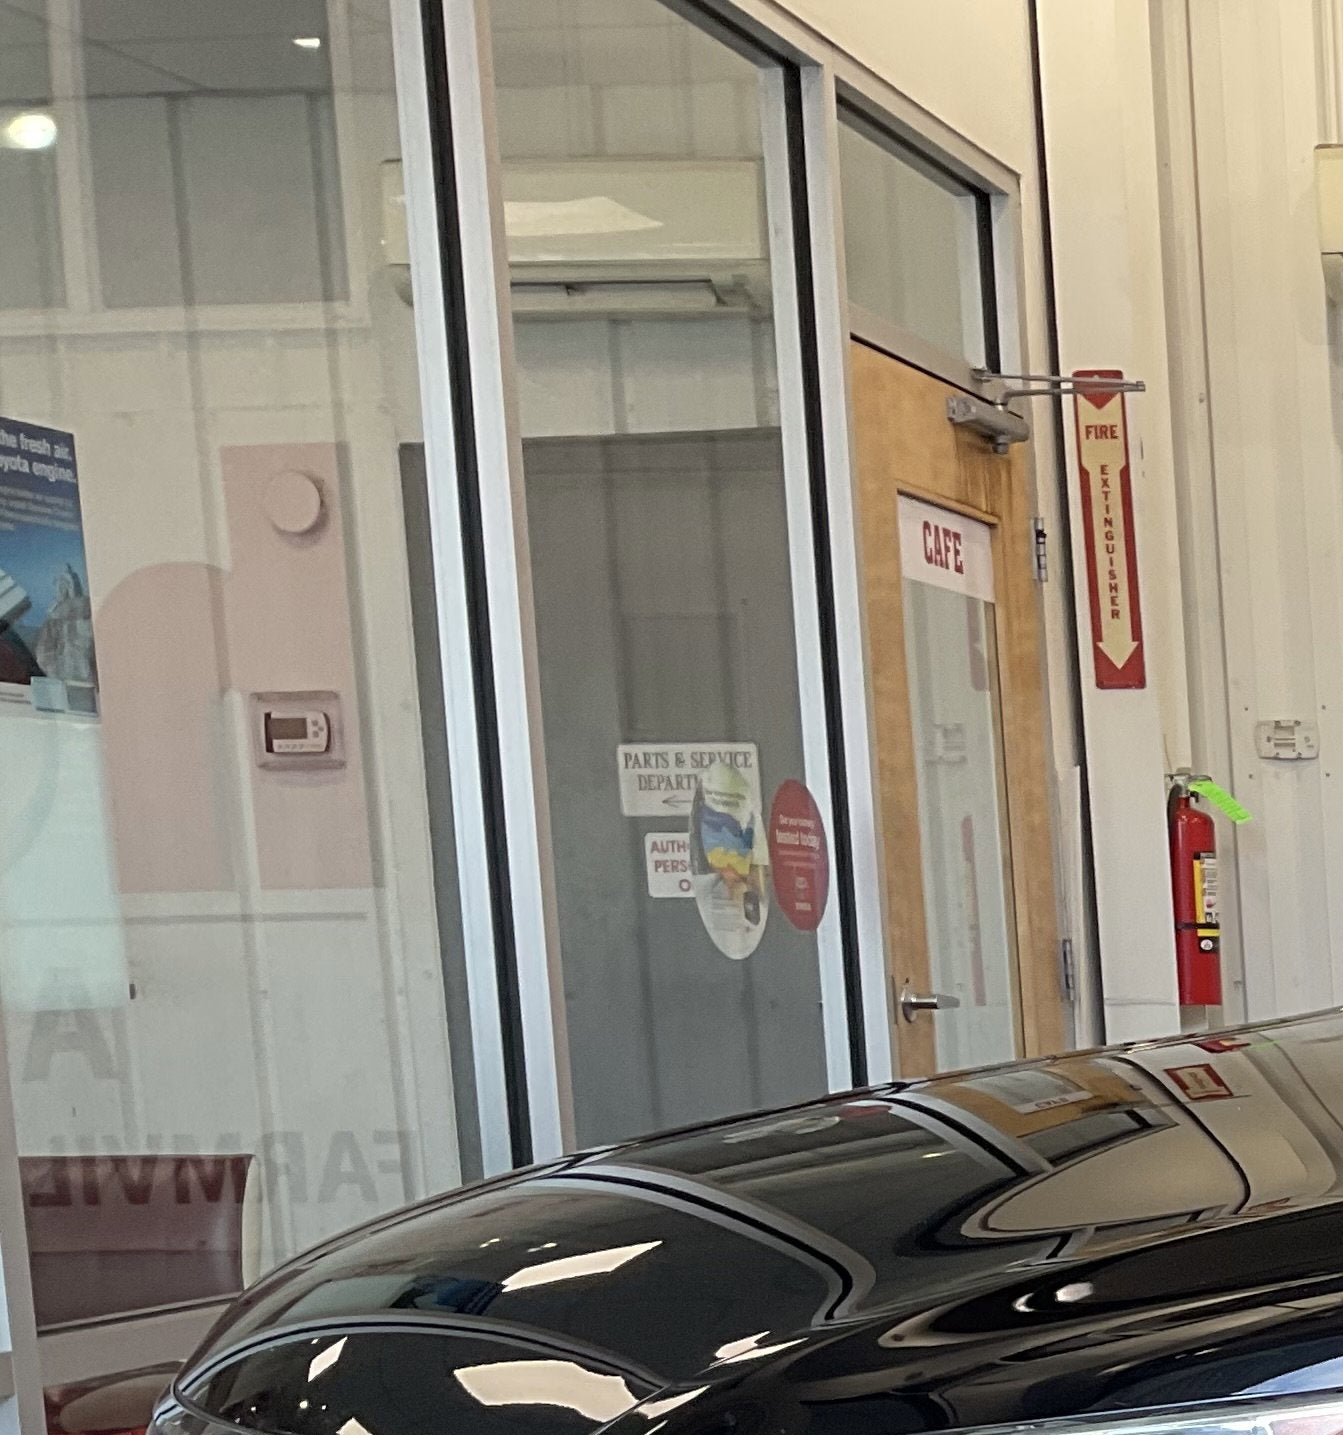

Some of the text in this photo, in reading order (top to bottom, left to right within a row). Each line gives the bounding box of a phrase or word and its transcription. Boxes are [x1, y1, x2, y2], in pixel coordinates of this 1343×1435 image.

[1085, 424, 1120, 440] FIRE
[20, 432, 51, 456] fresh
[0, 454, 30, 473] yota
[922, 520, 964, 575] CAFE
[1101, 464, 1120, 620] EXTINGUISHER
[623, 751, 753, 769] PARTS & SERVICE
